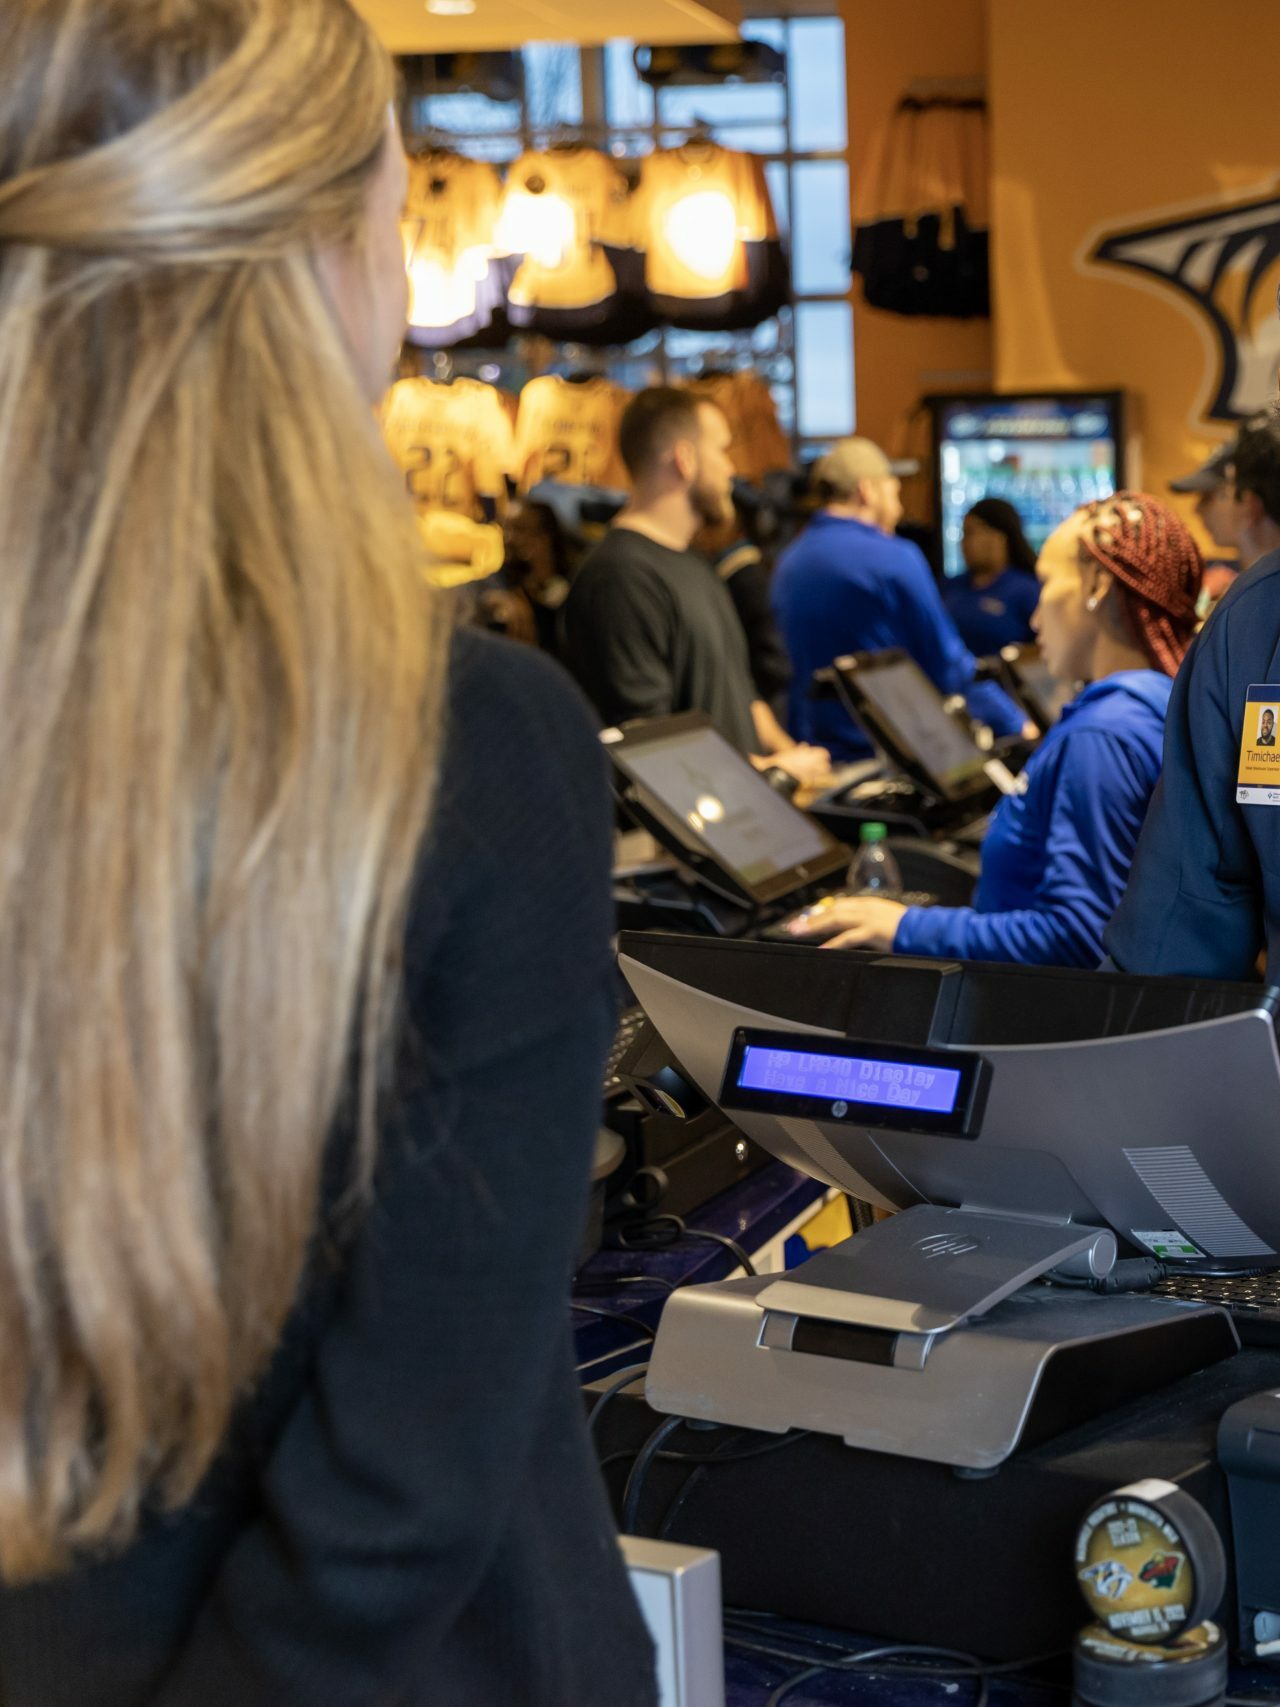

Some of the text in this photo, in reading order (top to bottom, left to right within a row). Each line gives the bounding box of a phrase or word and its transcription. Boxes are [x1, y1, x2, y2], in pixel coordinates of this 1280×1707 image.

[763, 1068, 807, 1090] Have
[835, 1077, 880, 1099] Nice
[886, 1083, 923, 1106] Day
[859, 1061, 937, 1089] Display
